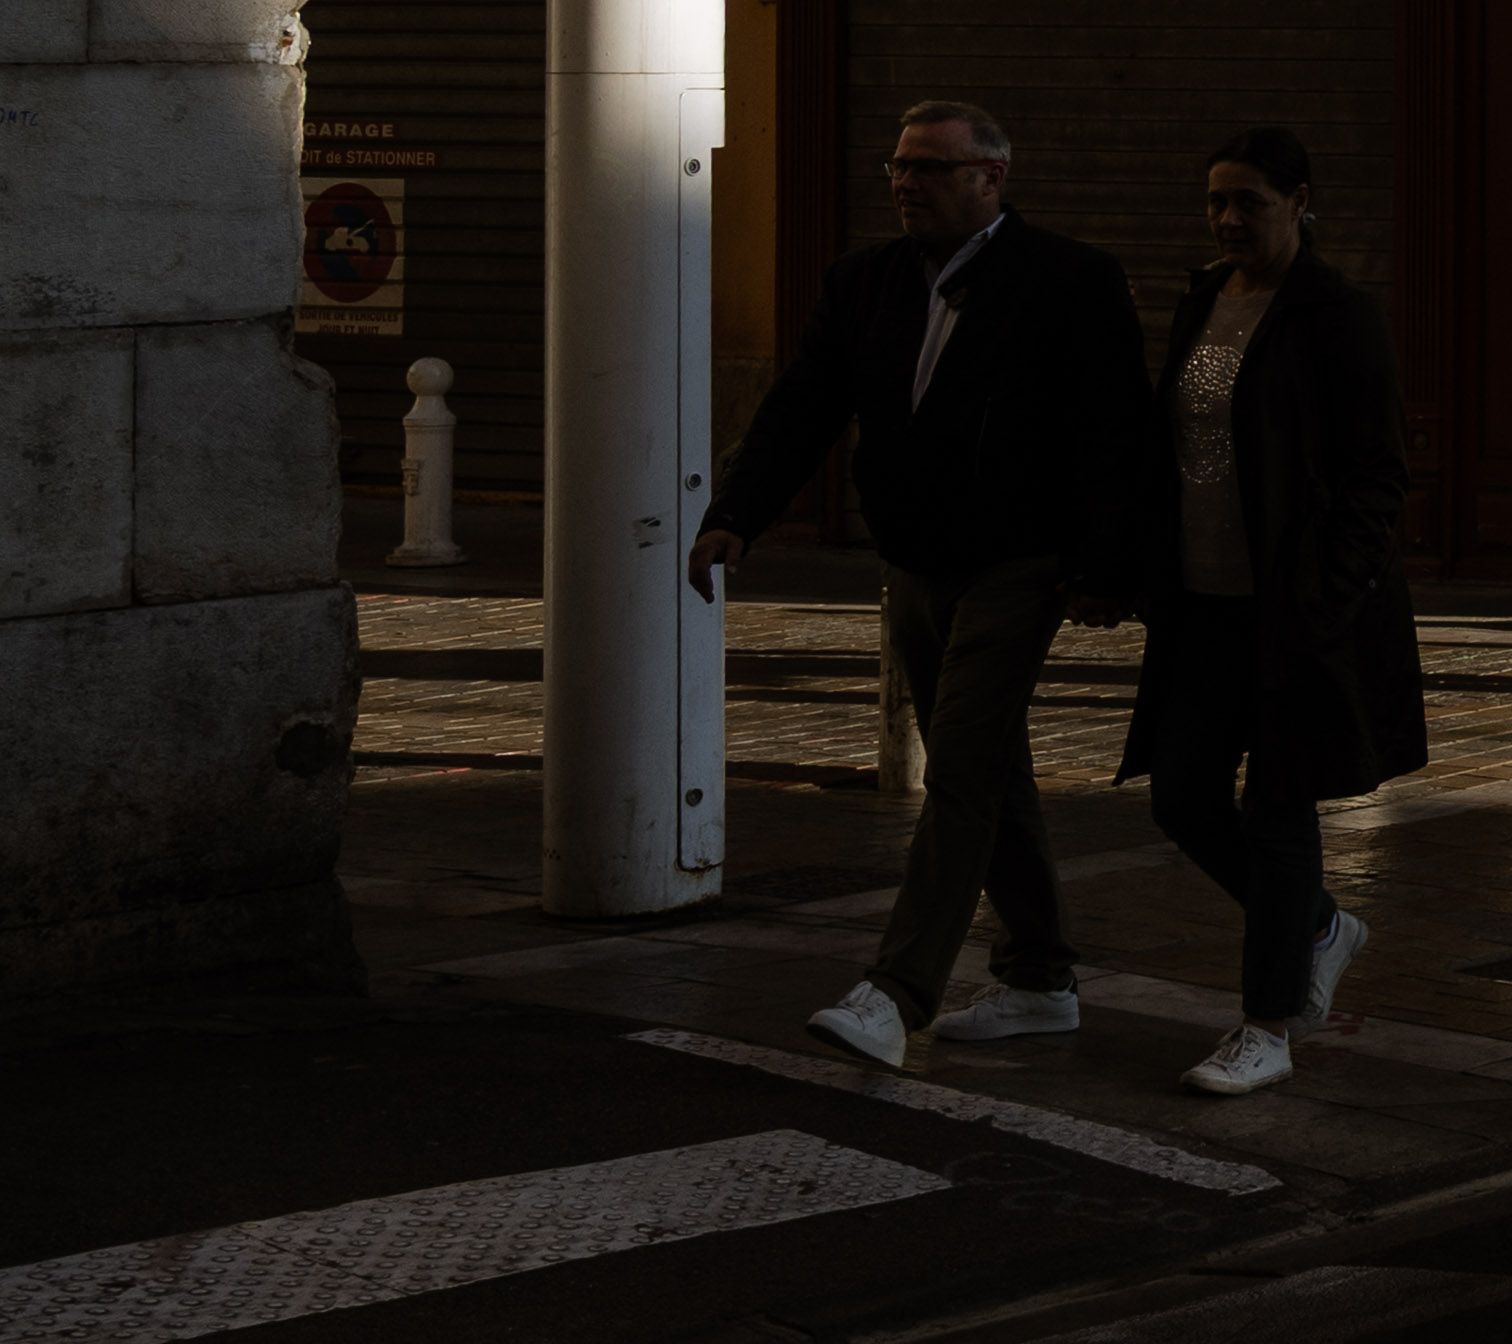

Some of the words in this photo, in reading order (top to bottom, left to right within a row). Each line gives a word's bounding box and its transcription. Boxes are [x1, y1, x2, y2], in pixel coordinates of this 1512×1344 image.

[304, 122, 395, 138] GARAGE
[326, 150, 343, 165] de
[346, 149, 436, 166] STATIONNER
